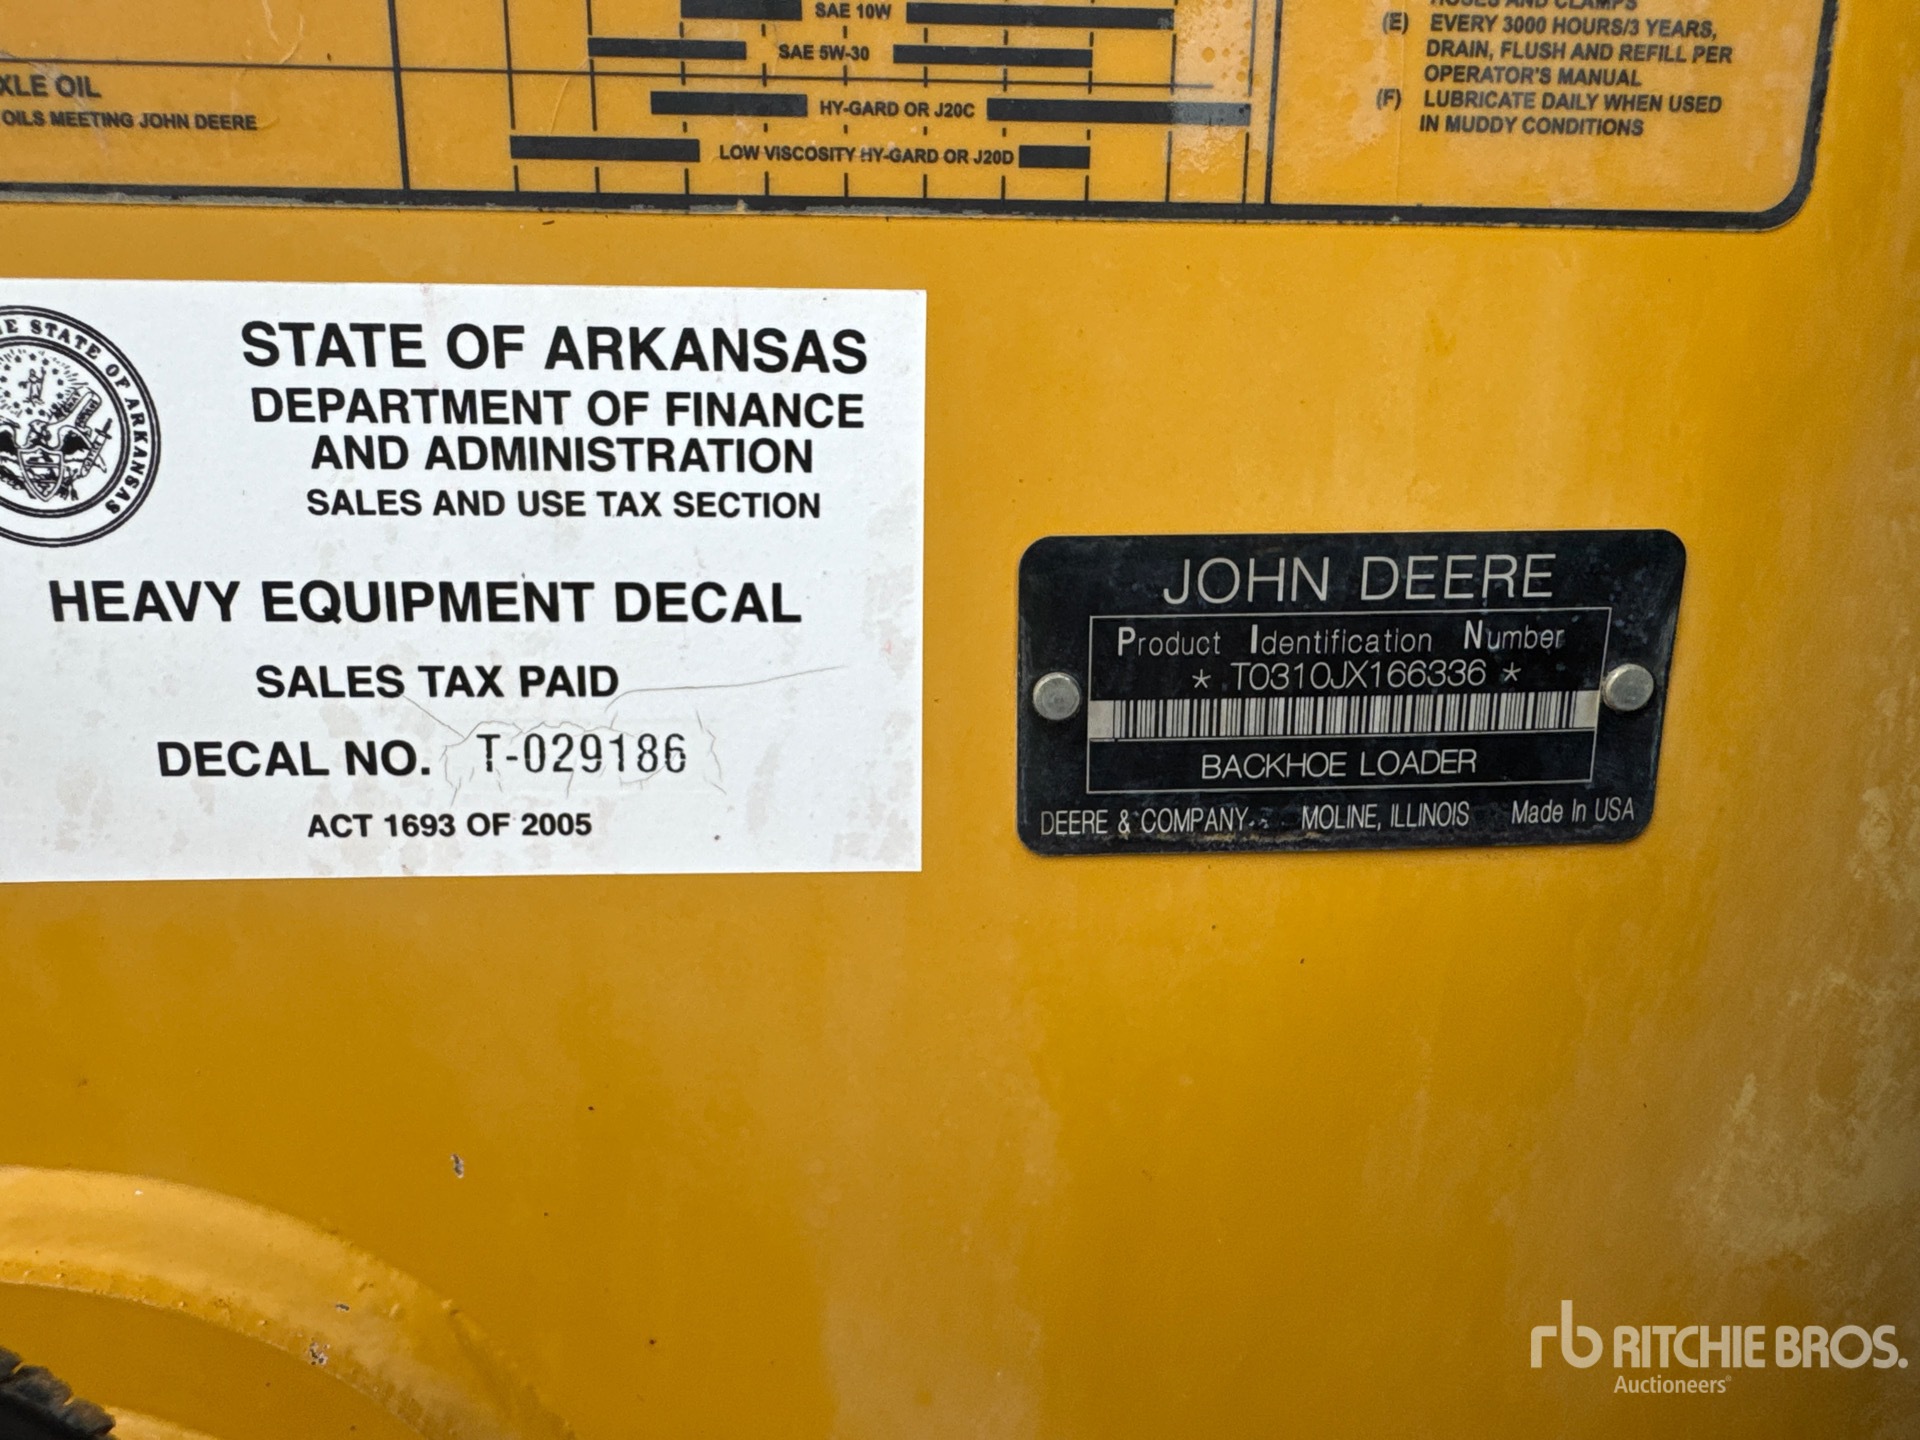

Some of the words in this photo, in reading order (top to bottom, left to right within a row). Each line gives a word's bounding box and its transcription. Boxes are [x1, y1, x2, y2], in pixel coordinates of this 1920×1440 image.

[814, 1, 850, 19] SAE
[856, 3, 892, 20] 10W
[1382, 11, 1409, 35] (E)
[1430, 13, 1498, 33] EVERY
[1502, 15, 1547, 35] 3000
[1551, 16, 1640, 37] HOURS/3
[1646, 18, 1717, 41] YEARS,
[778, 43, 815, 61] SAE
[819, 44, 870, 62] 5W-30
[1426, 38, 1494, 61] DRAIN,
[1500, 40, 1567, 61] FLUSH
[1569, 42, 1614, 62] AND
[1618, 43, 1688, 64] REFILL
[1691, 45, 1733, 64] PER
[54, 74, 102, 99] OIL
[1424, 64, 1552, 86] OPERATOR'S
[1557, 67, 1642, 88] MANUAL
[819, 100, 900, 117] HY-GARD
[903, 101, 930, 118] OR
[933, 102, 975, 119] J20C
[1376, 88, 1402, 112] (F)
[1423, 89, 1537, 110] LUBRICATE
[1541, 92, 1600, 111] DAILY
[1603, 93, 1663, 113] WHEN
[1668, 94, 1723, 114] USED
[1, 109, 47, 127] OILS
[49, 110, 135, 129] MEETING
[139, 112, 191, 130] JOHN
[194, 113, 258, 131] DEERE
[1419, 114, 1440, 133] IN
[1444, 114, 1518, 134] MUDDY
[1521, 116, 1645, 137] CONDITIONS
[719, 144, 761, 161] LOW
[763, 145, 856, 163] VISCOSITY
[860, 147, 940, 164] HY-GARD
[942, 148, 969, 165] OR
[972, 149, 1015, 166] J20D
[0, 319, 18, 335] E
[30, 319, 102, 360] STATE
[241, 320, 427, 369] STATE
[446, 323, 525, 370] OF
[544, 325, 867, 375] ARKANSAS
[106, 363, 131, 389] OF
[251, 386, 572, 426] DEPARTMENT
[587, 389, 650, 427] OF
[666, 391, 864, 429] FINANCE
[105, 397, 149, 515] ARKANSAS
[311, 434, 409, 470] AND
[424, 435, 813, 474] ADMINISTRATION
[306, 488, 423, 517] SALES
[432, 489, 506, 517] AND
[517, 489, 587, 518] USE
[596, 490, 662, 517] TAX
[673, 490, 820, 519] SECTION
[1163, 556, 1330, 605] JOHN
[1360, 553, 1556, 601] DEERE
[48, 580, 241, 623] HEAVY
[261, 579, 595, 625] EQUIPMENT
[614, 581, 802, 624] DECAL
[1117, 626, 1221, 657] Product
[1250, 623, 1432, 656] Identification
[1463, 619, 1565, 651] Number
[255, 664, 405, 699] SALES
[417, 665, 505, 698] TAX
[519, 665, 619, 698] PAID
[157, 740, 330, 778] DECAL
[344, 739, 431, 777] NO.
[476, 732, 687, 774] T-029186
[1201, 751, 1348, 780] BACKHOE
[1360, 748, 1477, 776] LOADER
[1040, 809, 1108, 837] DEERE
[1117, 809, 1131, 835] &
[1140, 806, 1249, 834] COMPANY
[1301, 803, 1381, 835] MOLINE,
[1390, 800, 1470, 828] ILLINOIS
[1511, 799, 1564, 824] Made
[1571, 798, 1587, 822] In
[1594, 796, 1635, 822] USA
[307, 813, 373, 839] ACT
[384, 813, 456, 838] 1693
[466, 812, 511, 837] OF
[521, 812, 592, 837] 2005
